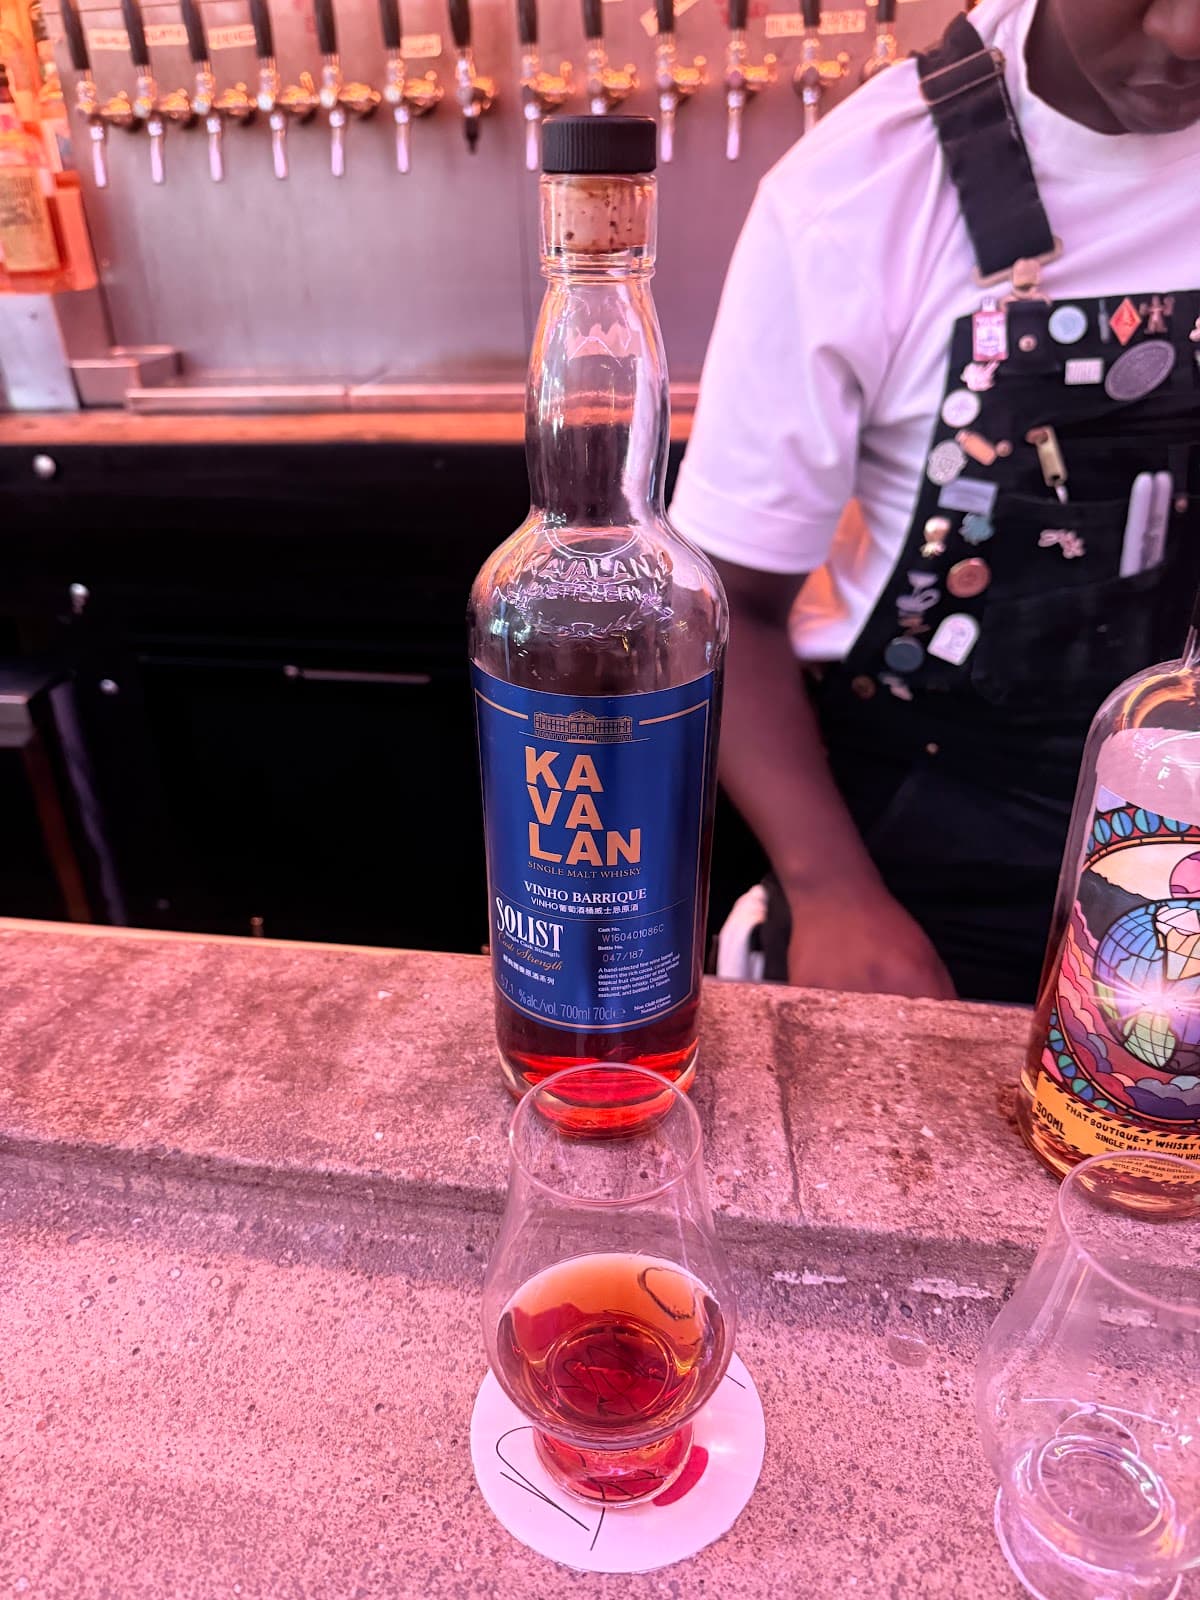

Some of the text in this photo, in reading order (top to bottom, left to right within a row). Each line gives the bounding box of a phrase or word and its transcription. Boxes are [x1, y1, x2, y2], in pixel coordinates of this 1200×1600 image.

[525, 746, 604, 792] KA
[527, 784, 604, 830] VA
[529, 822, 641, 867] LAN
[528, 861, 642, 879] SINGLE MALT WHISKY
[524, 880, 647, 904] VINHO BARRIQUE
[496, 897, 563, 952] SOLIST
[602, 924, 664, 943] W160401086C
[516, 949, 563, 971] Strength
[602, 948, 644, 962] 047/187
[629, 972, 652, 982] character
[632, 985, 650, 994] bottled
[560, 1004, 590, 1020] 700ml
[1036, 1101, 1066, 1136] 500ML
[1065, 1103, 1089, 1121] THAT
[1090, 1118, 1153, 1145] BOUTIQUE-Y
[1095, 1132, 1125, 1149] SINGLE
